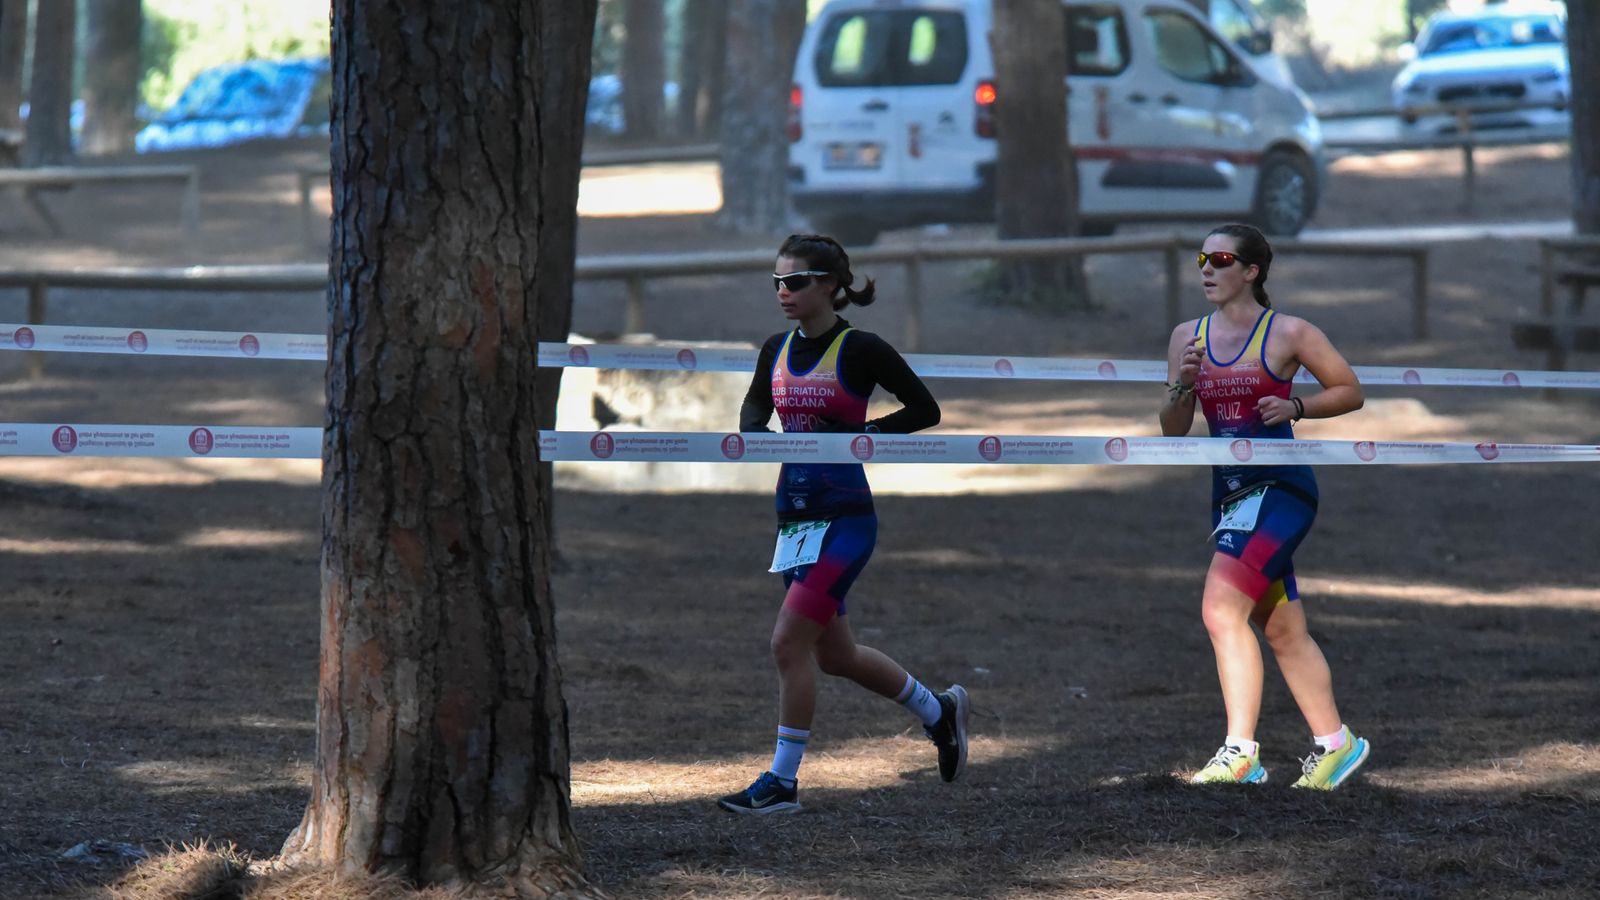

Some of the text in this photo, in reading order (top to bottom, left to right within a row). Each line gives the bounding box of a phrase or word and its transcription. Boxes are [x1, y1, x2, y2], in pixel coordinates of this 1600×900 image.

[1216, 377, 1260, 387] TRIATLON
[788, 386, 835, 397] TRIATLON
[1200, 387, 1253, 399] CHICLANA
[774, 397, 826, 408] CHICLANA
[1216, 401, 1242, 421] RUIZ
[780, 412, 828, 432] CAMPO
[796, 533, 808, 557] 1
